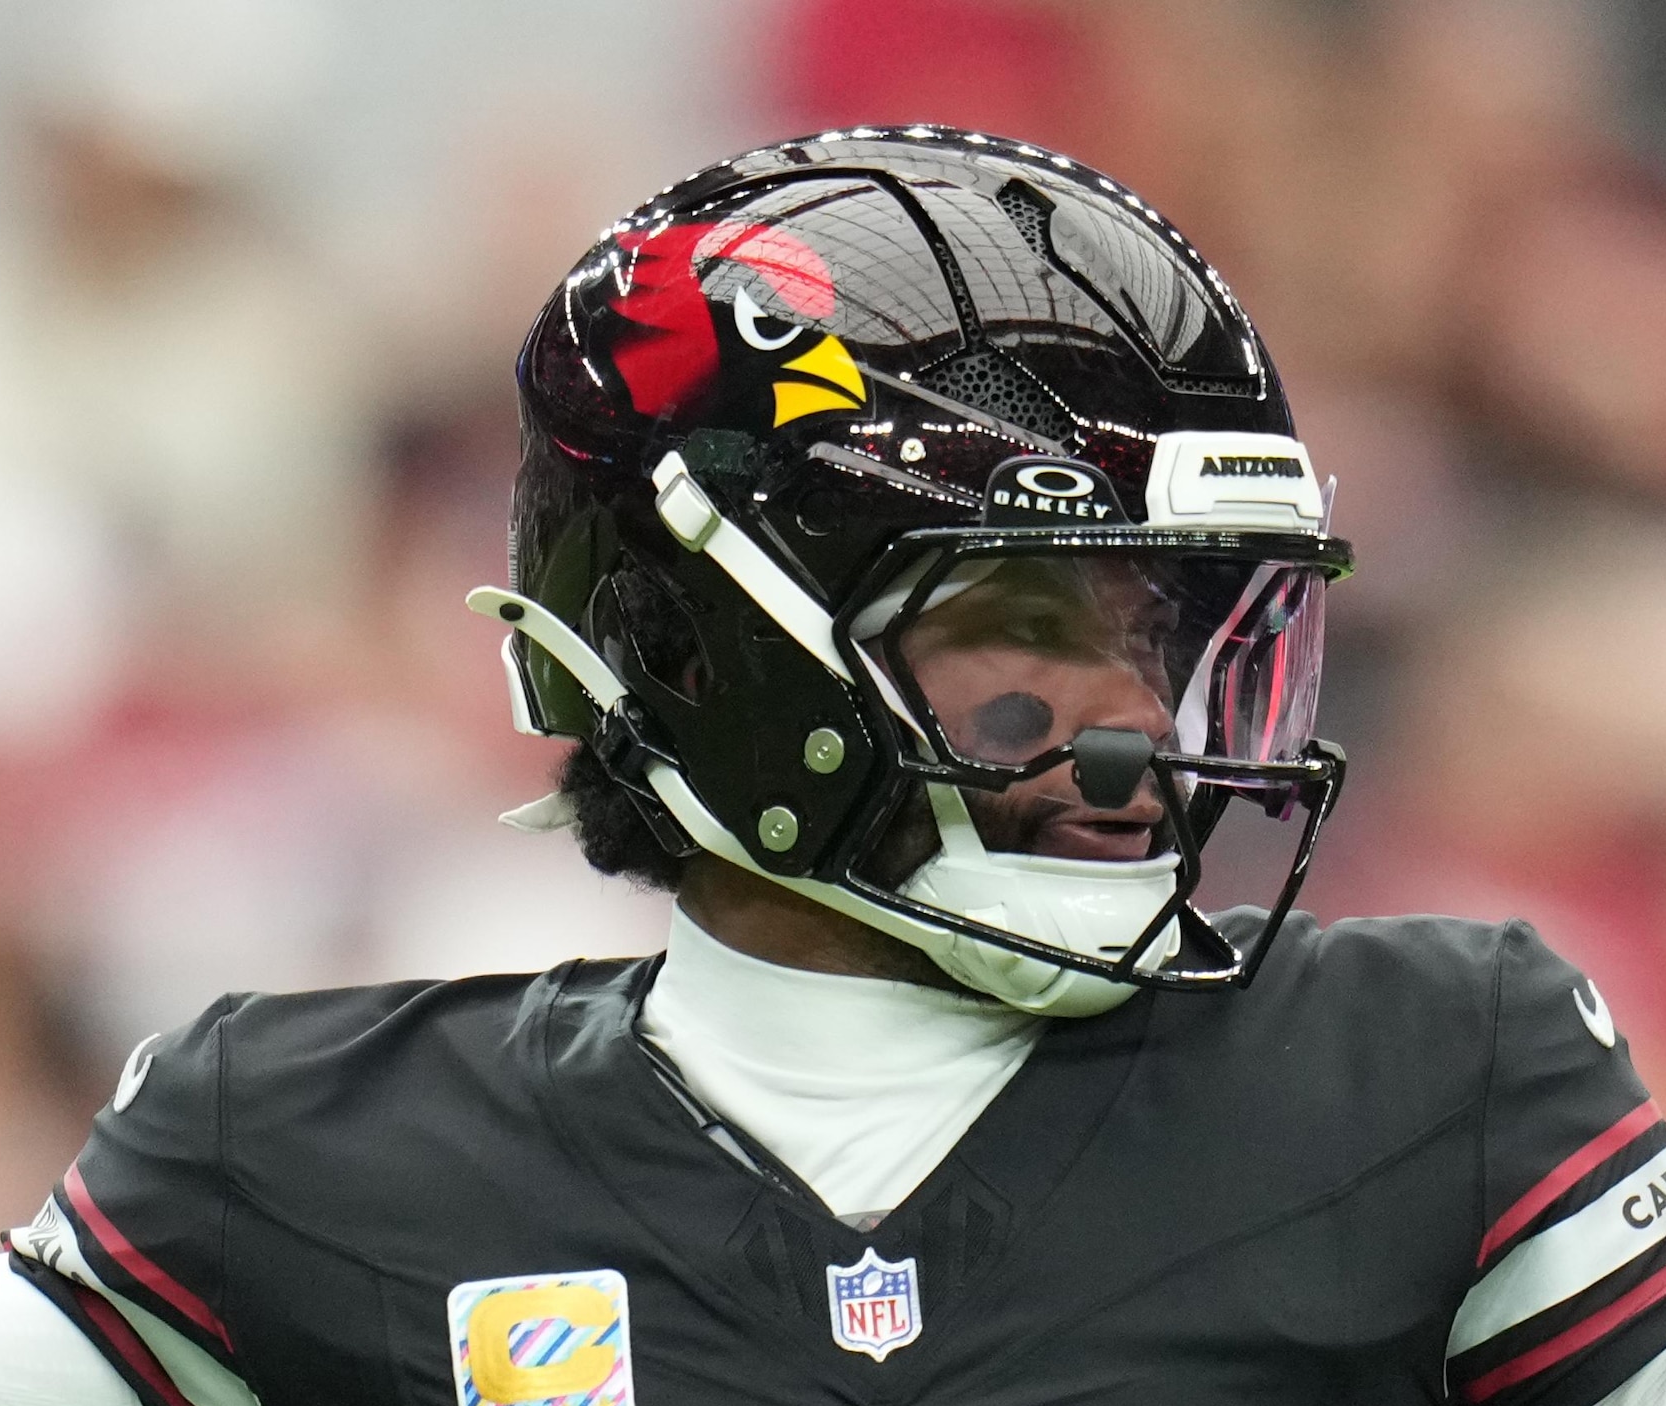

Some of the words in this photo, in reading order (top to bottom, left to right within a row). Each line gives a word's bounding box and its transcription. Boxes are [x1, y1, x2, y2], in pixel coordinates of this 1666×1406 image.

[993, 489, 1110, 519] OAKLEY
[845, 1298, 907, 1339] NFL
[467, 1284, 620, 1405] C
